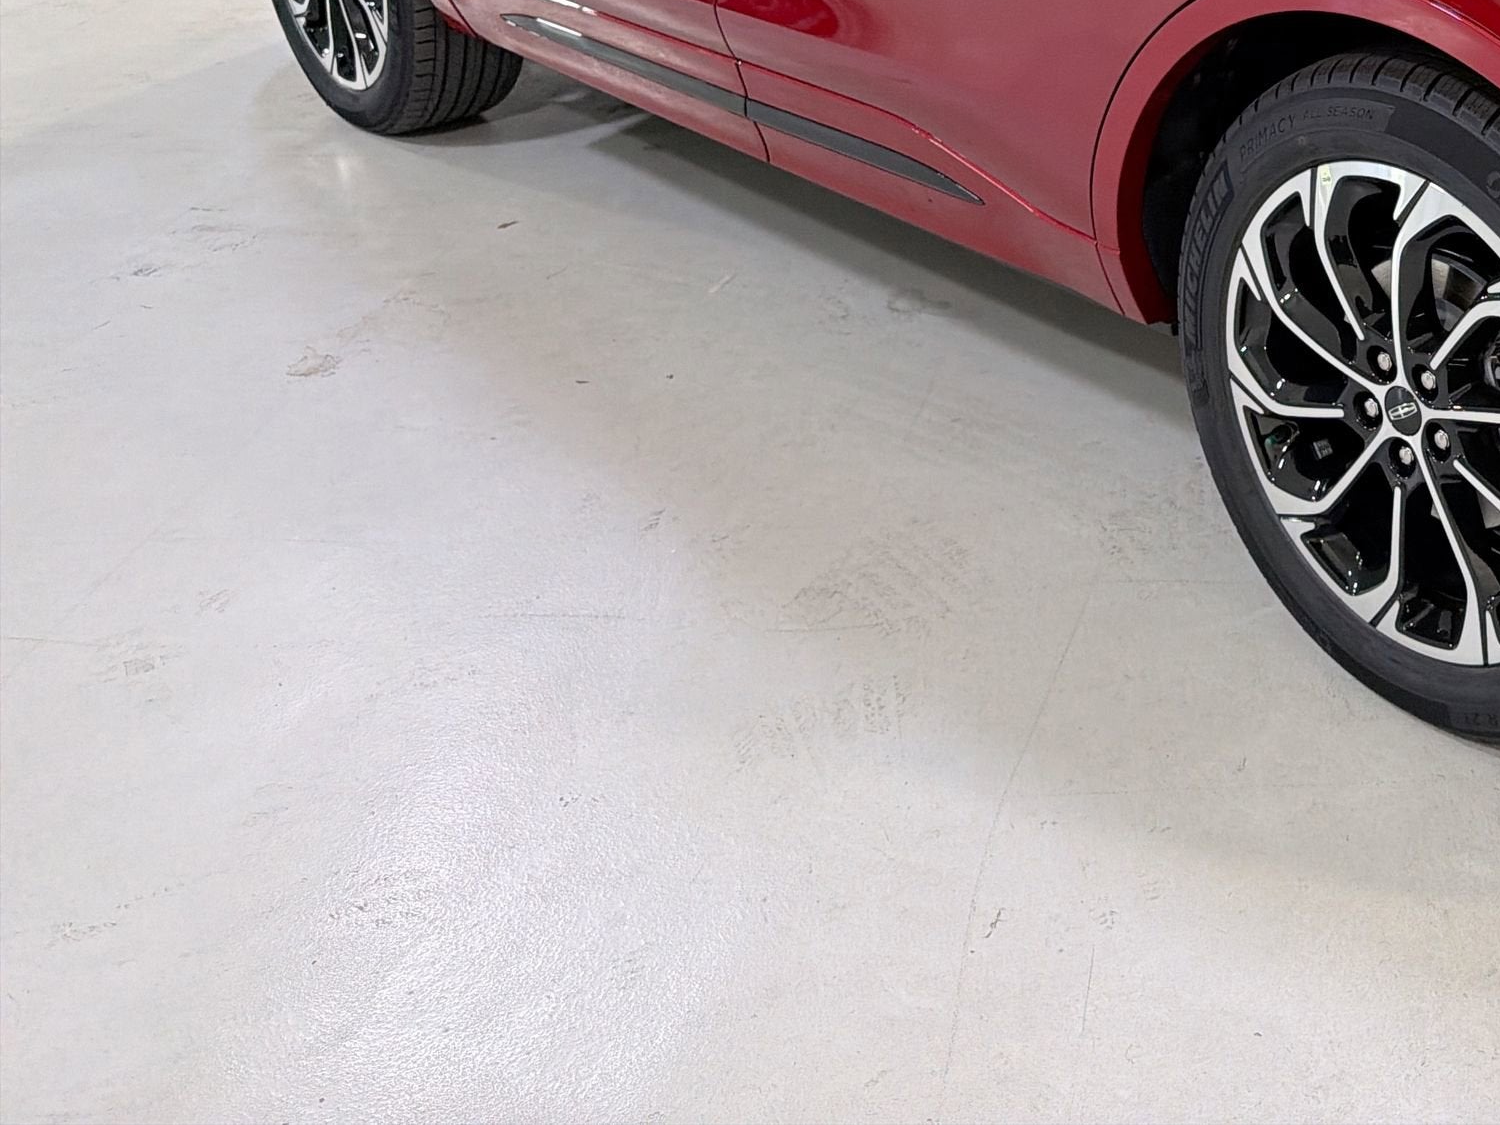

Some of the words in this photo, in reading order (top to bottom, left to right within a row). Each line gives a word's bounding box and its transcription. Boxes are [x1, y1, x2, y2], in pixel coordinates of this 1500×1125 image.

[1239, 114, 1296, 165] PRIMACY
[1303, 108, 1321, 120] ALL
[1327, 106, 1374, 120] SEASON
